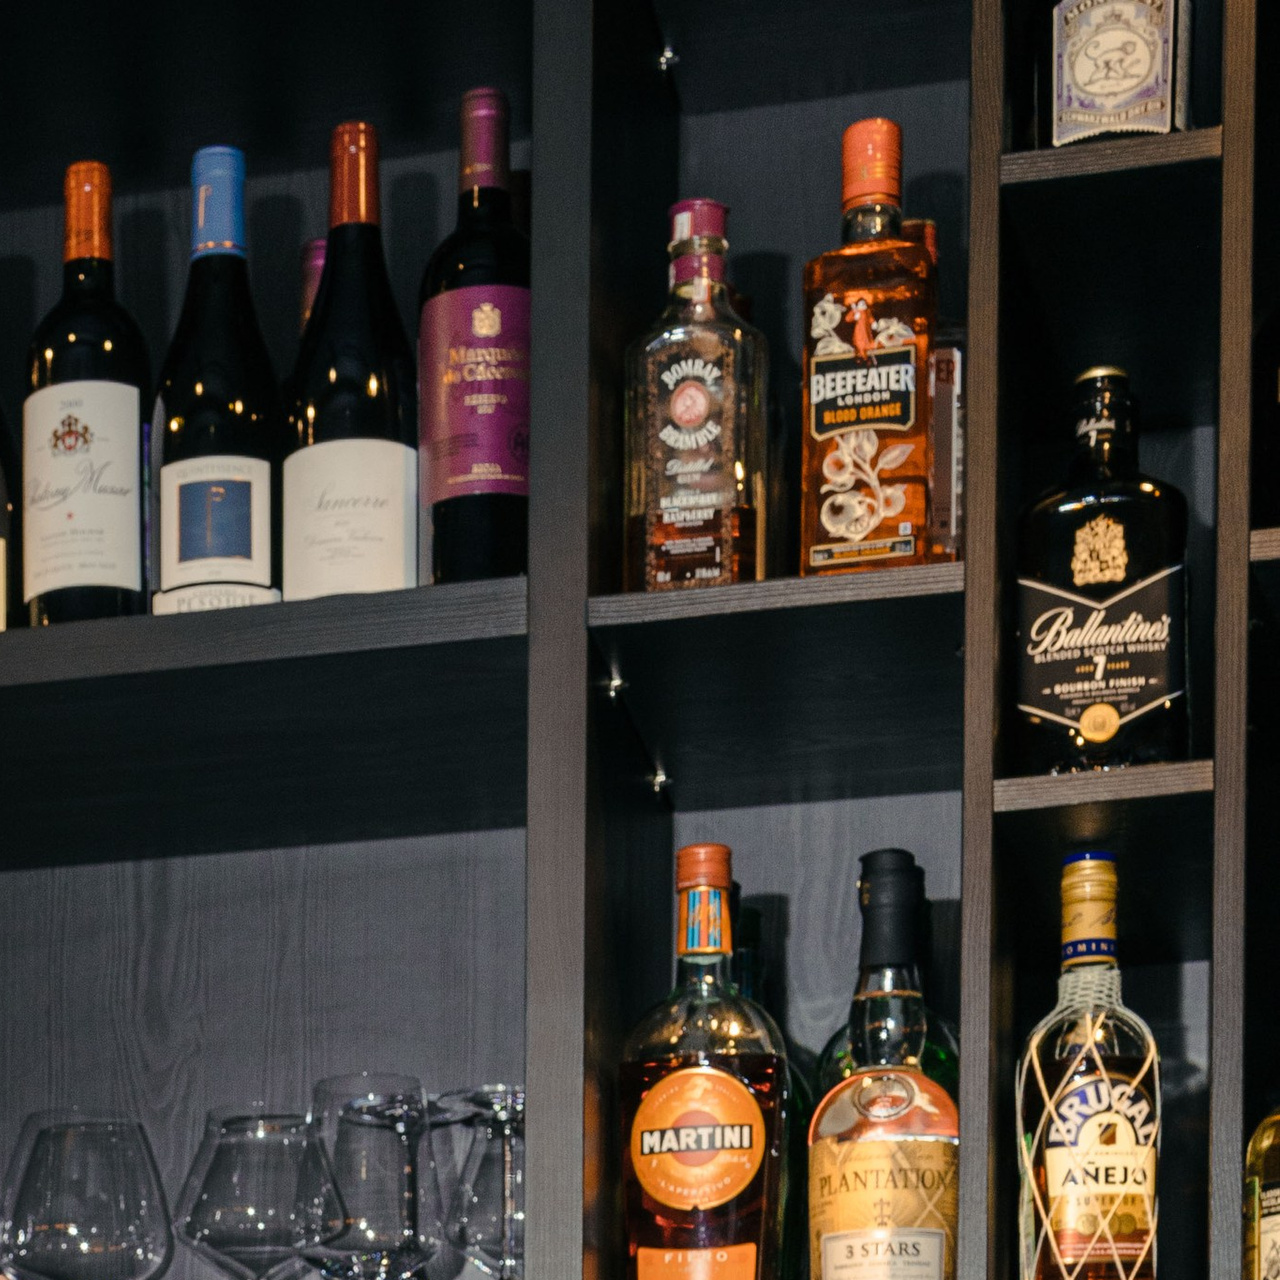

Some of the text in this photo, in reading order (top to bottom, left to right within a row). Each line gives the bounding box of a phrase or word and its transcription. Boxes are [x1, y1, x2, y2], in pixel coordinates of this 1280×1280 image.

[661, 358, 721, 390] BOMBAY
[810, 363, 915, 404] BEEFEATER
[837, 391, 891, 406] LONDON
[824, 403, 902, 424] BLOOD ORANGE
[659, 420, 722, 450] BRAMBLE
[1026, 606, 1171, 656] Ballantine's
[1034, 640, 1168, 664] BLENDED SCOTCH WHISKY
[1092, 654, 1107, 681] 7
[1053, 676, 1146, 695] BOURBON FINISH
[1048, 1081, 1157, 1147] BRUGAL
[641, 1125, 751, 1155] MARTINI
[820, 1168, 948, 1198] PLANTATION
[1062, 1160, 1149, 1187] AÑEJO
[846, 1241, 922, 1259] 3 STARS
